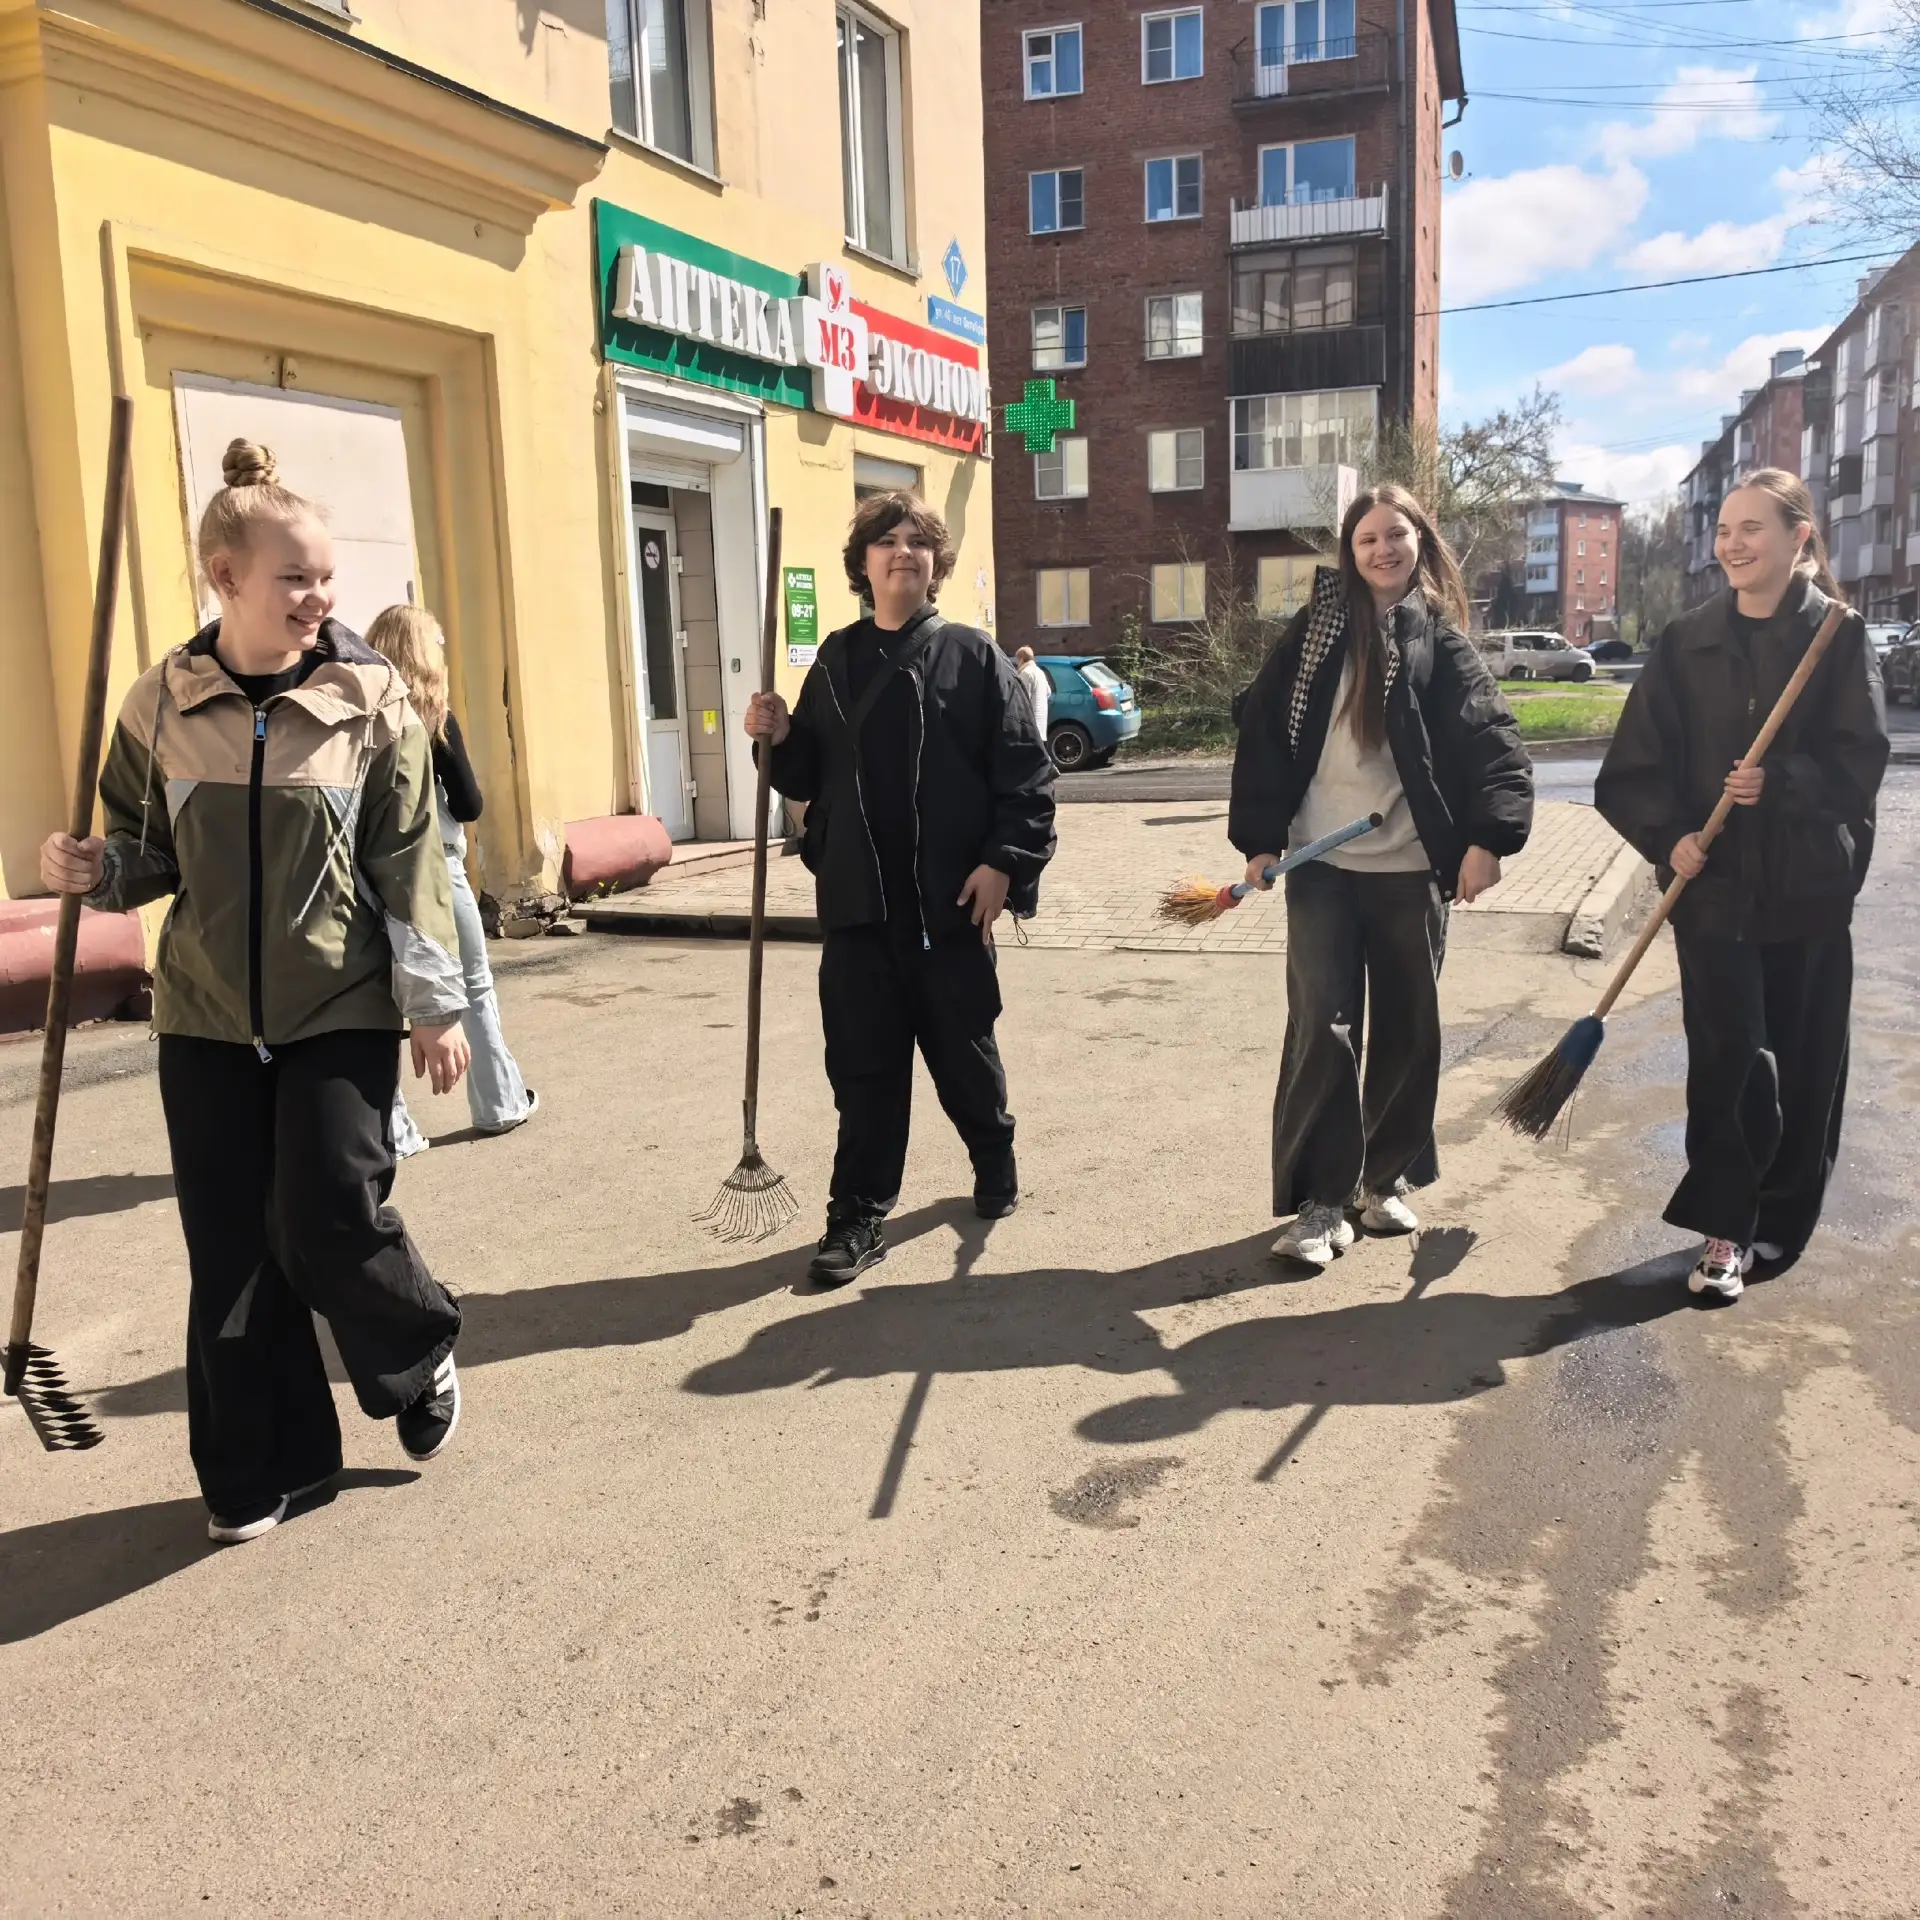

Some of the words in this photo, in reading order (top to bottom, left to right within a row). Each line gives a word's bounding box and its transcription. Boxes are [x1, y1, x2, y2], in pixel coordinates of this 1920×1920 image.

[621, 243, 798, 367] АПТЕКА
[950, 255, 961, 285] 17
[873, 331, 989, 424] ЭКОНОМ
